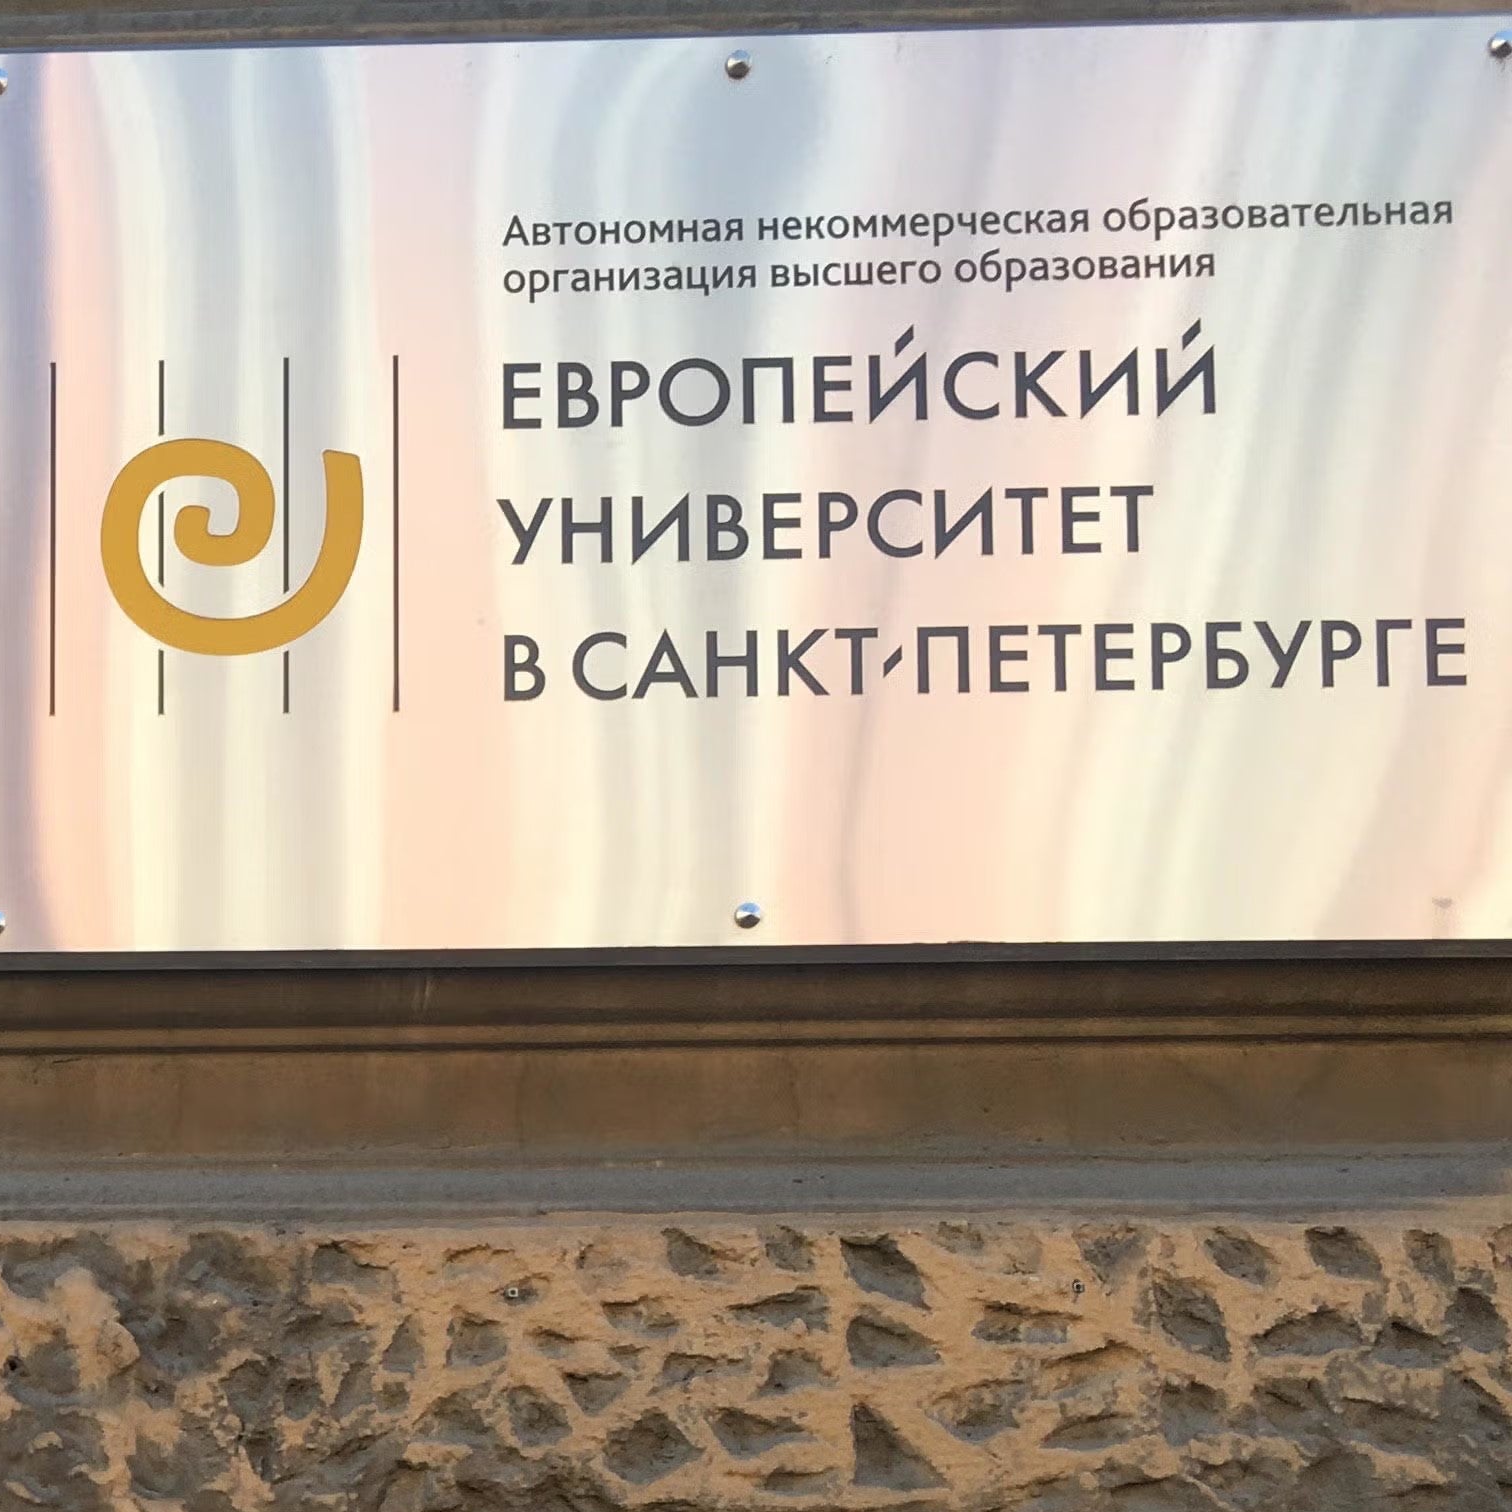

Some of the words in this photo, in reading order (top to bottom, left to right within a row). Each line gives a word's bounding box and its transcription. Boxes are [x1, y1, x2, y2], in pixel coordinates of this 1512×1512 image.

[501, 214, 744, 247] Автономная
[757, 208, 1090, 248] некоммерческая
[1102, 196, 1453, 242] образовательная
[503, 264, 757, 304] организация
[770, 259, 942, 288] высшего
[954, 247, 1216, 293] образования
[502, 317, 1217, 430] ЕВРОПЕЙСКИЙ
[495, 484, 1155, 566] УНИВЕРСИТЕТ
[503, 634, 547, 702] В
[571, 617, 1468, 702] САНКТ-ПЕТЕРБУРГЕ
